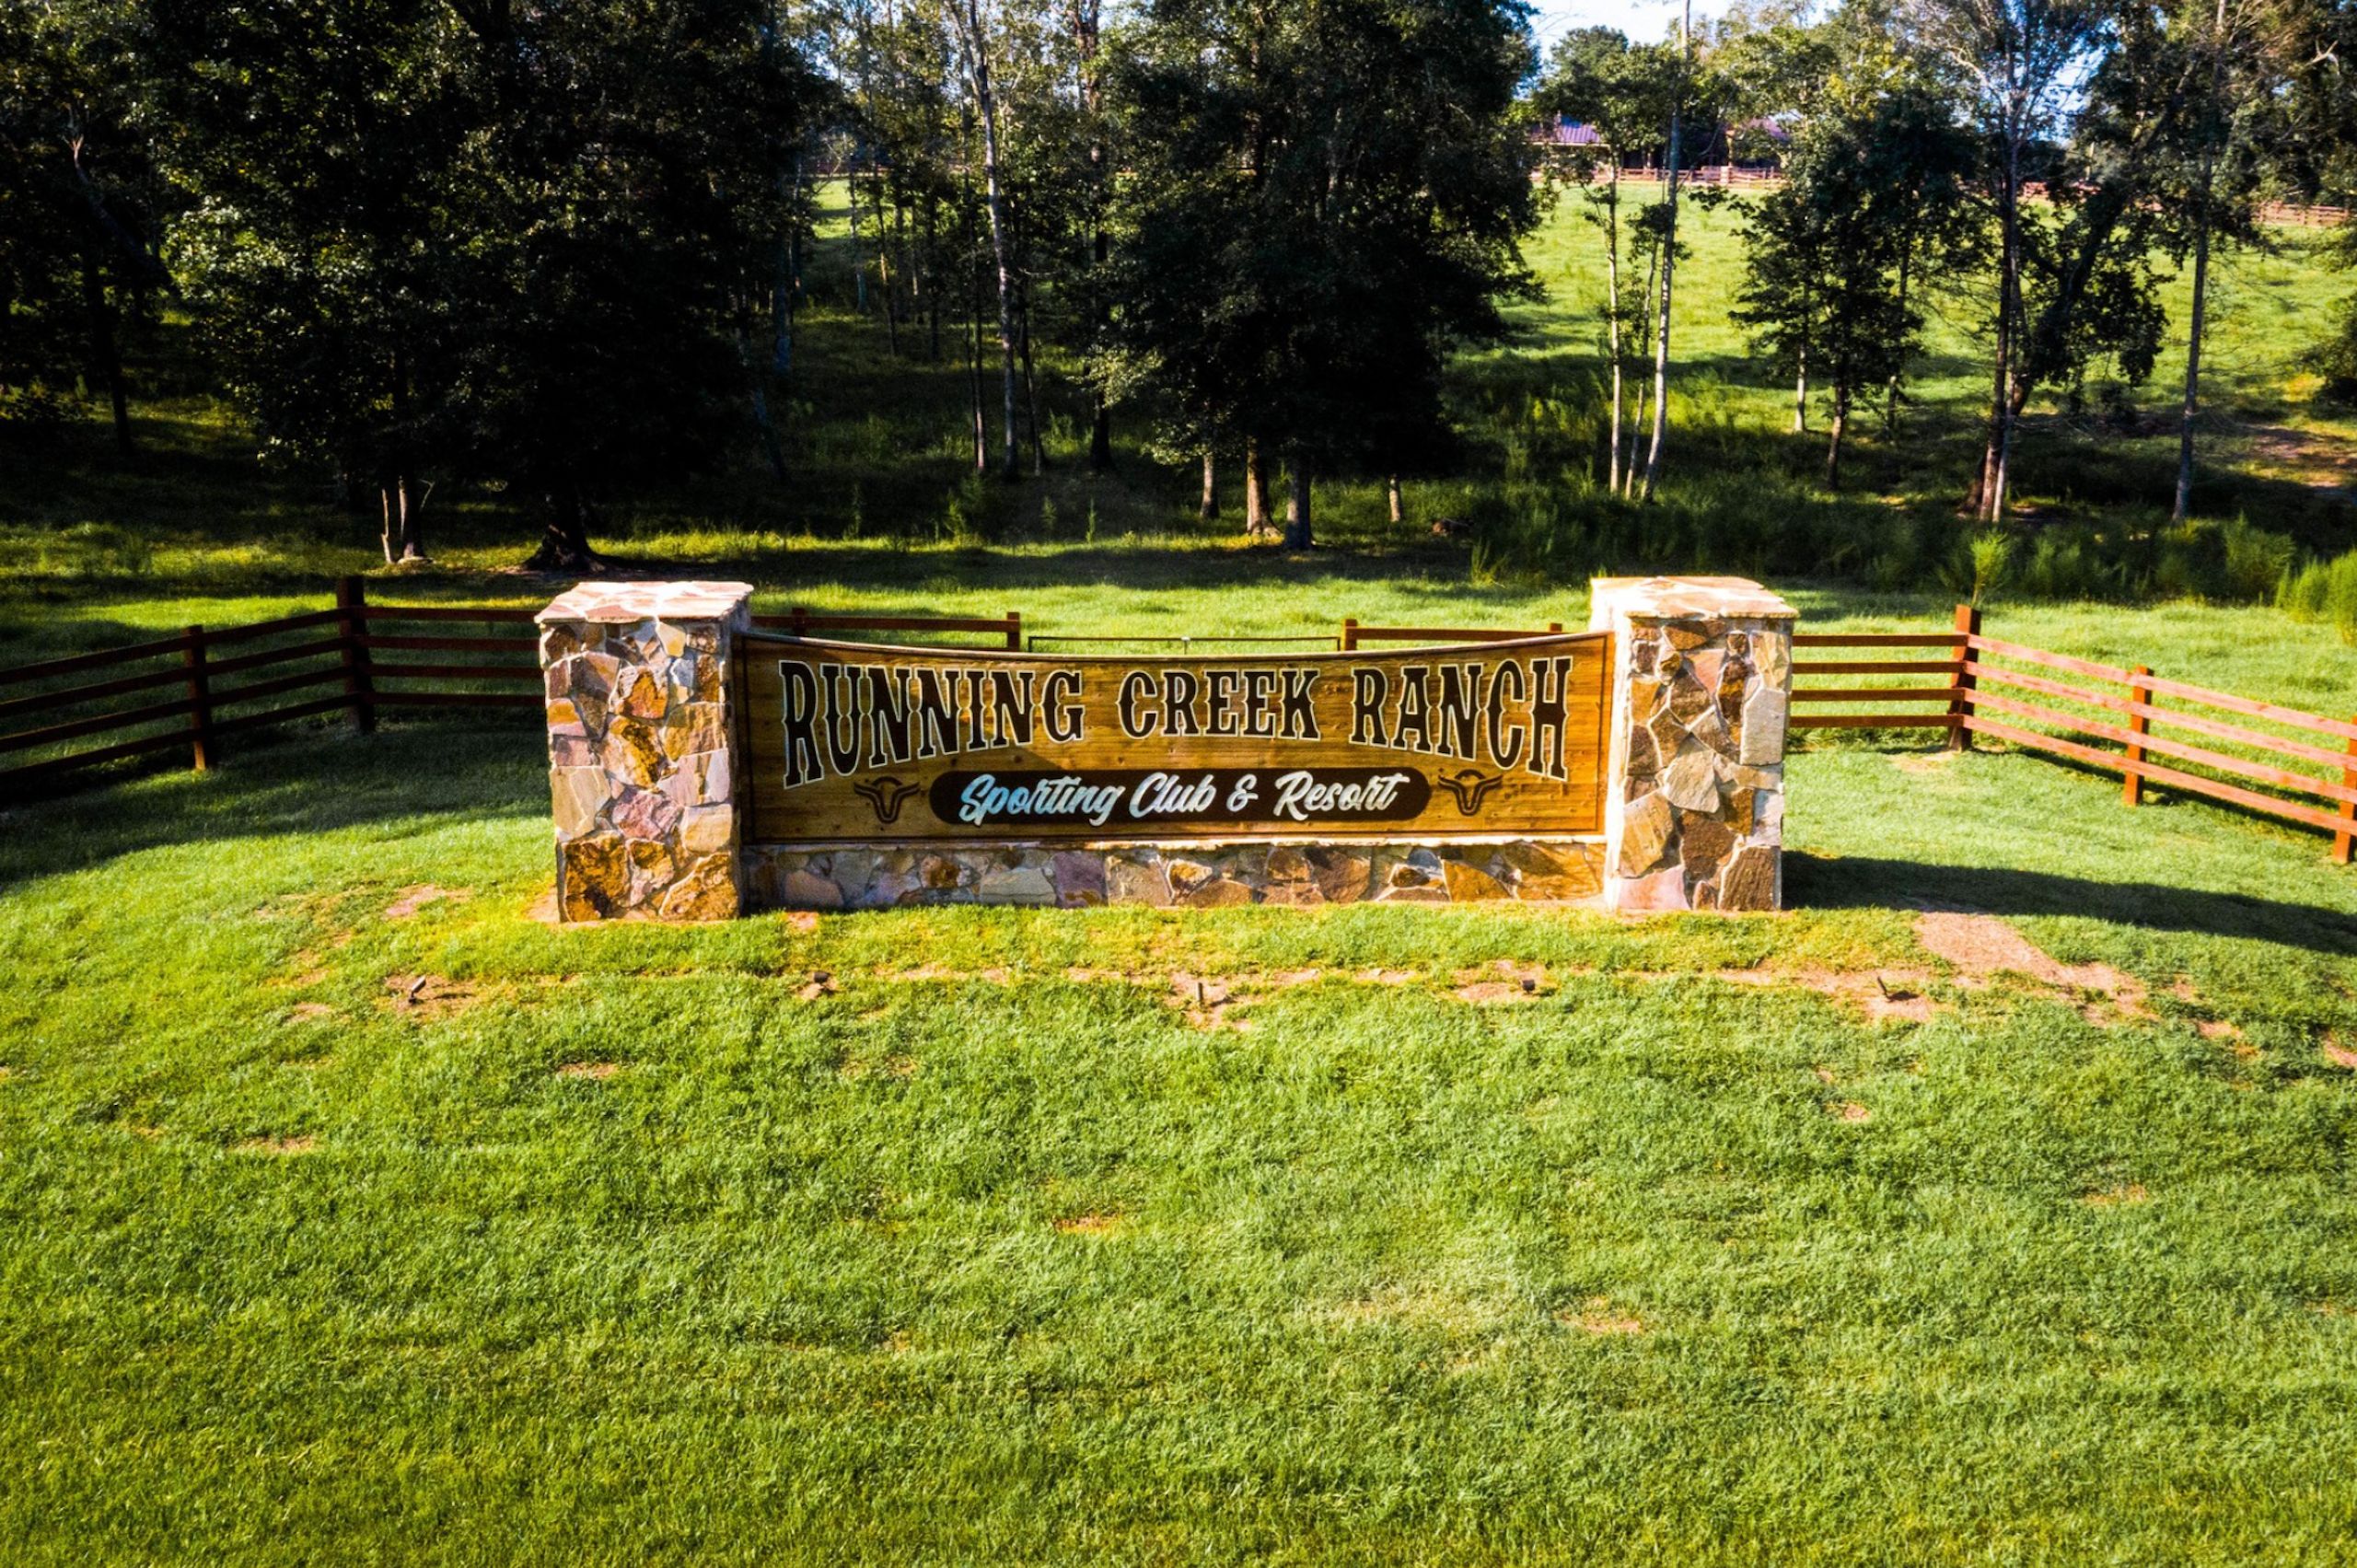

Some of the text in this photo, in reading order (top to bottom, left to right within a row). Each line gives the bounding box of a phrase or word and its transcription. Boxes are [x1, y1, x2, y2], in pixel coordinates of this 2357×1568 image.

[778, 656, 1573, 790] RUNNING CREEK RANCH
[958, 771, 1411, 827] Sporting Club & Resort
